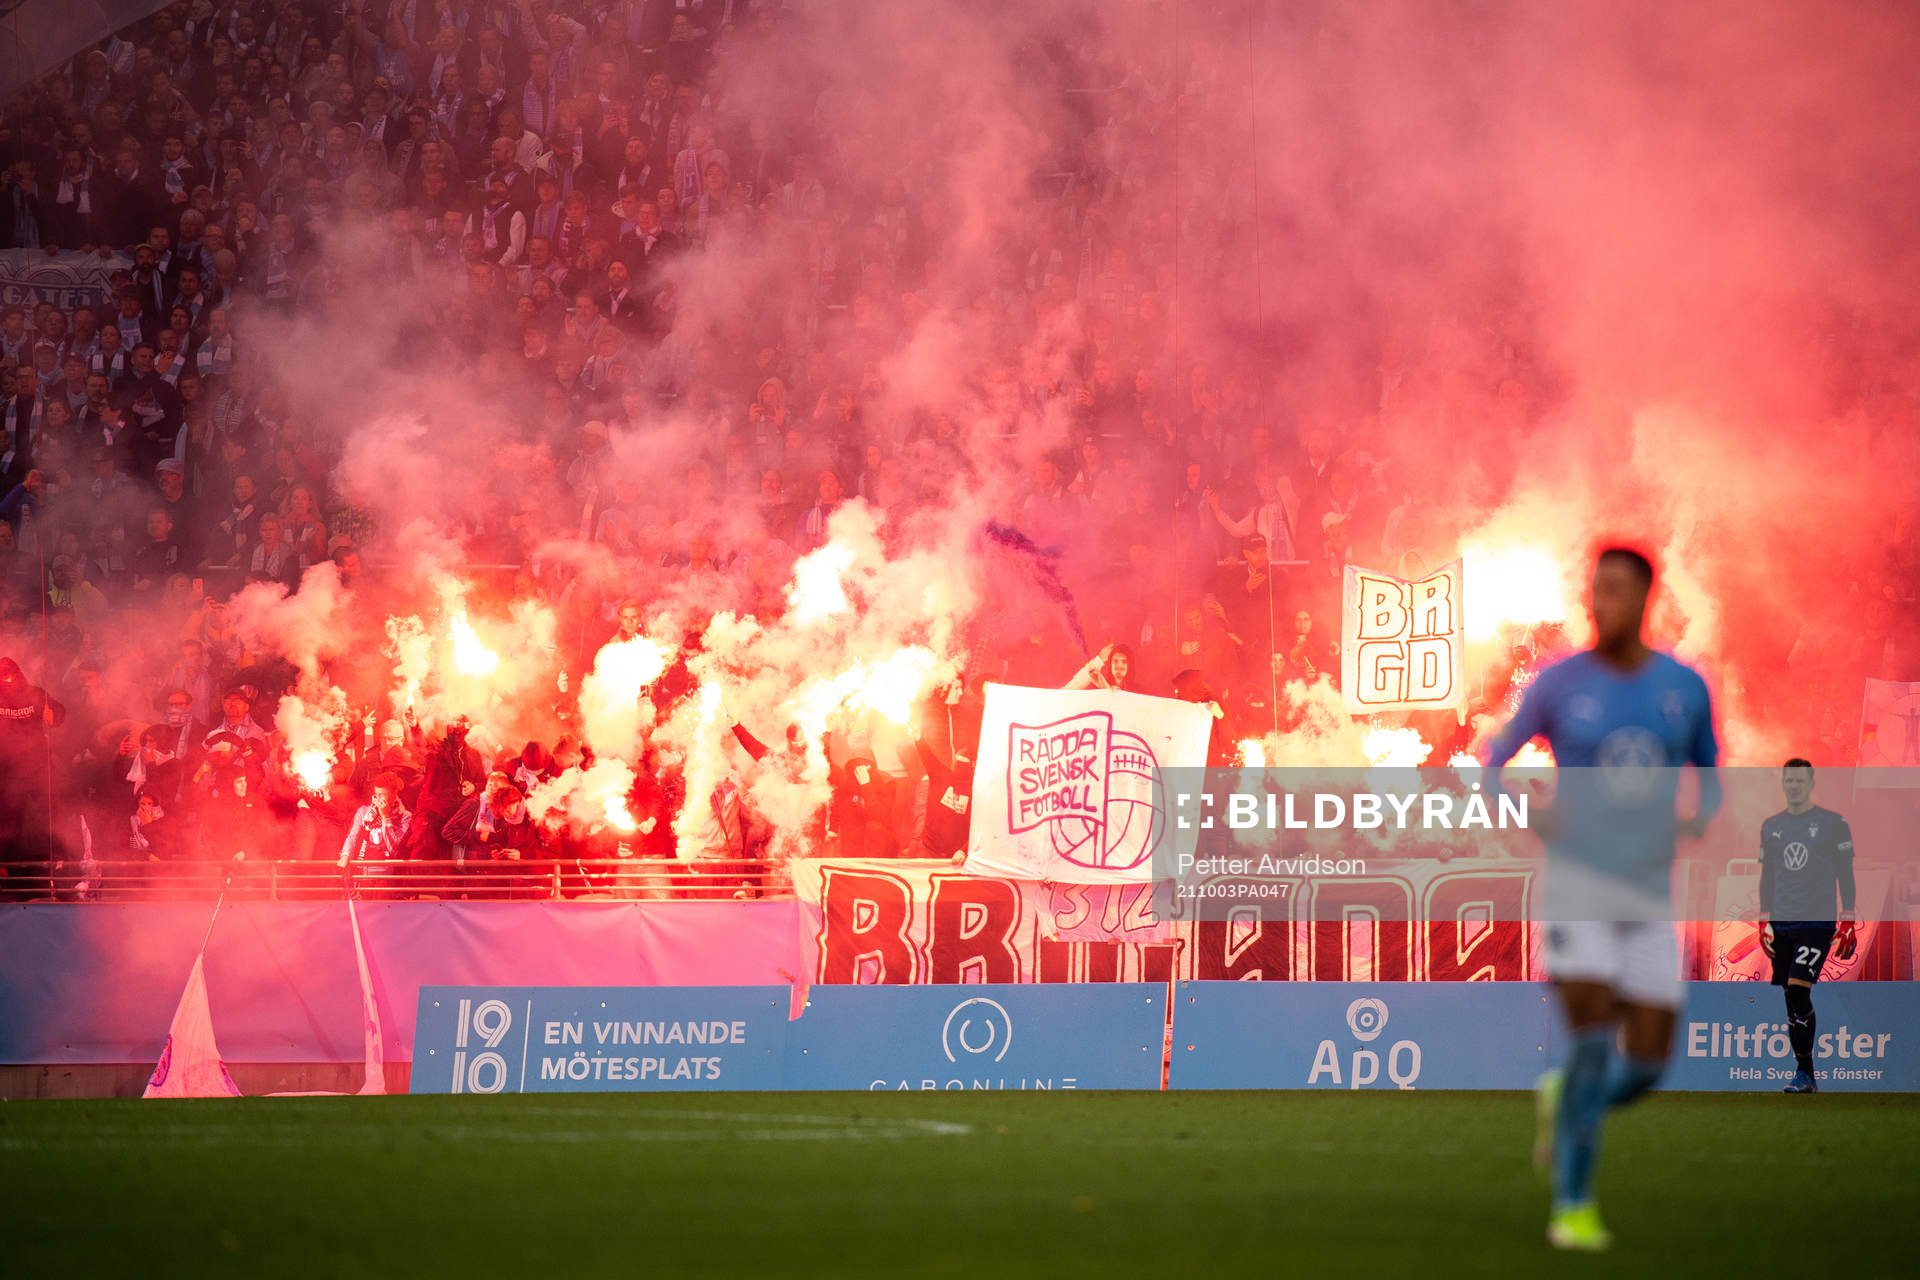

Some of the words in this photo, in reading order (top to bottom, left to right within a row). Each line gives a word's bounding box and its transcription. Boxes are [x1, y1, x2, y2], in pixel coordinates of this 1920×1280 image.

[1357, 575, 1453, 640] BR
[1357, 637, 1452, 704] GD
[1020, 728, 1098, 763] RÄDDA
[1019, 756, 1099, 794] SVENSK
[1019, 786, 1097, 823] FOTBOLL
[1795, 945, 1822, 967] 27
[455, 999, 512, 1048] 19
[544, 1022, 583, 1044] EN
[593, 1021, 746, 1044] VINNANDE
[1687, 1022, 1891, 1058] Elitföster
[540, 1051, 722, 1080] MÖTESPLATS
[1307, 1039, 1422, 1090] ApQ
[1729, 1067, 1762, 1080] Hela
[1766, 1067, 1828, 1080] Svees
[1832, 1067, 1884, 1080] fönster
